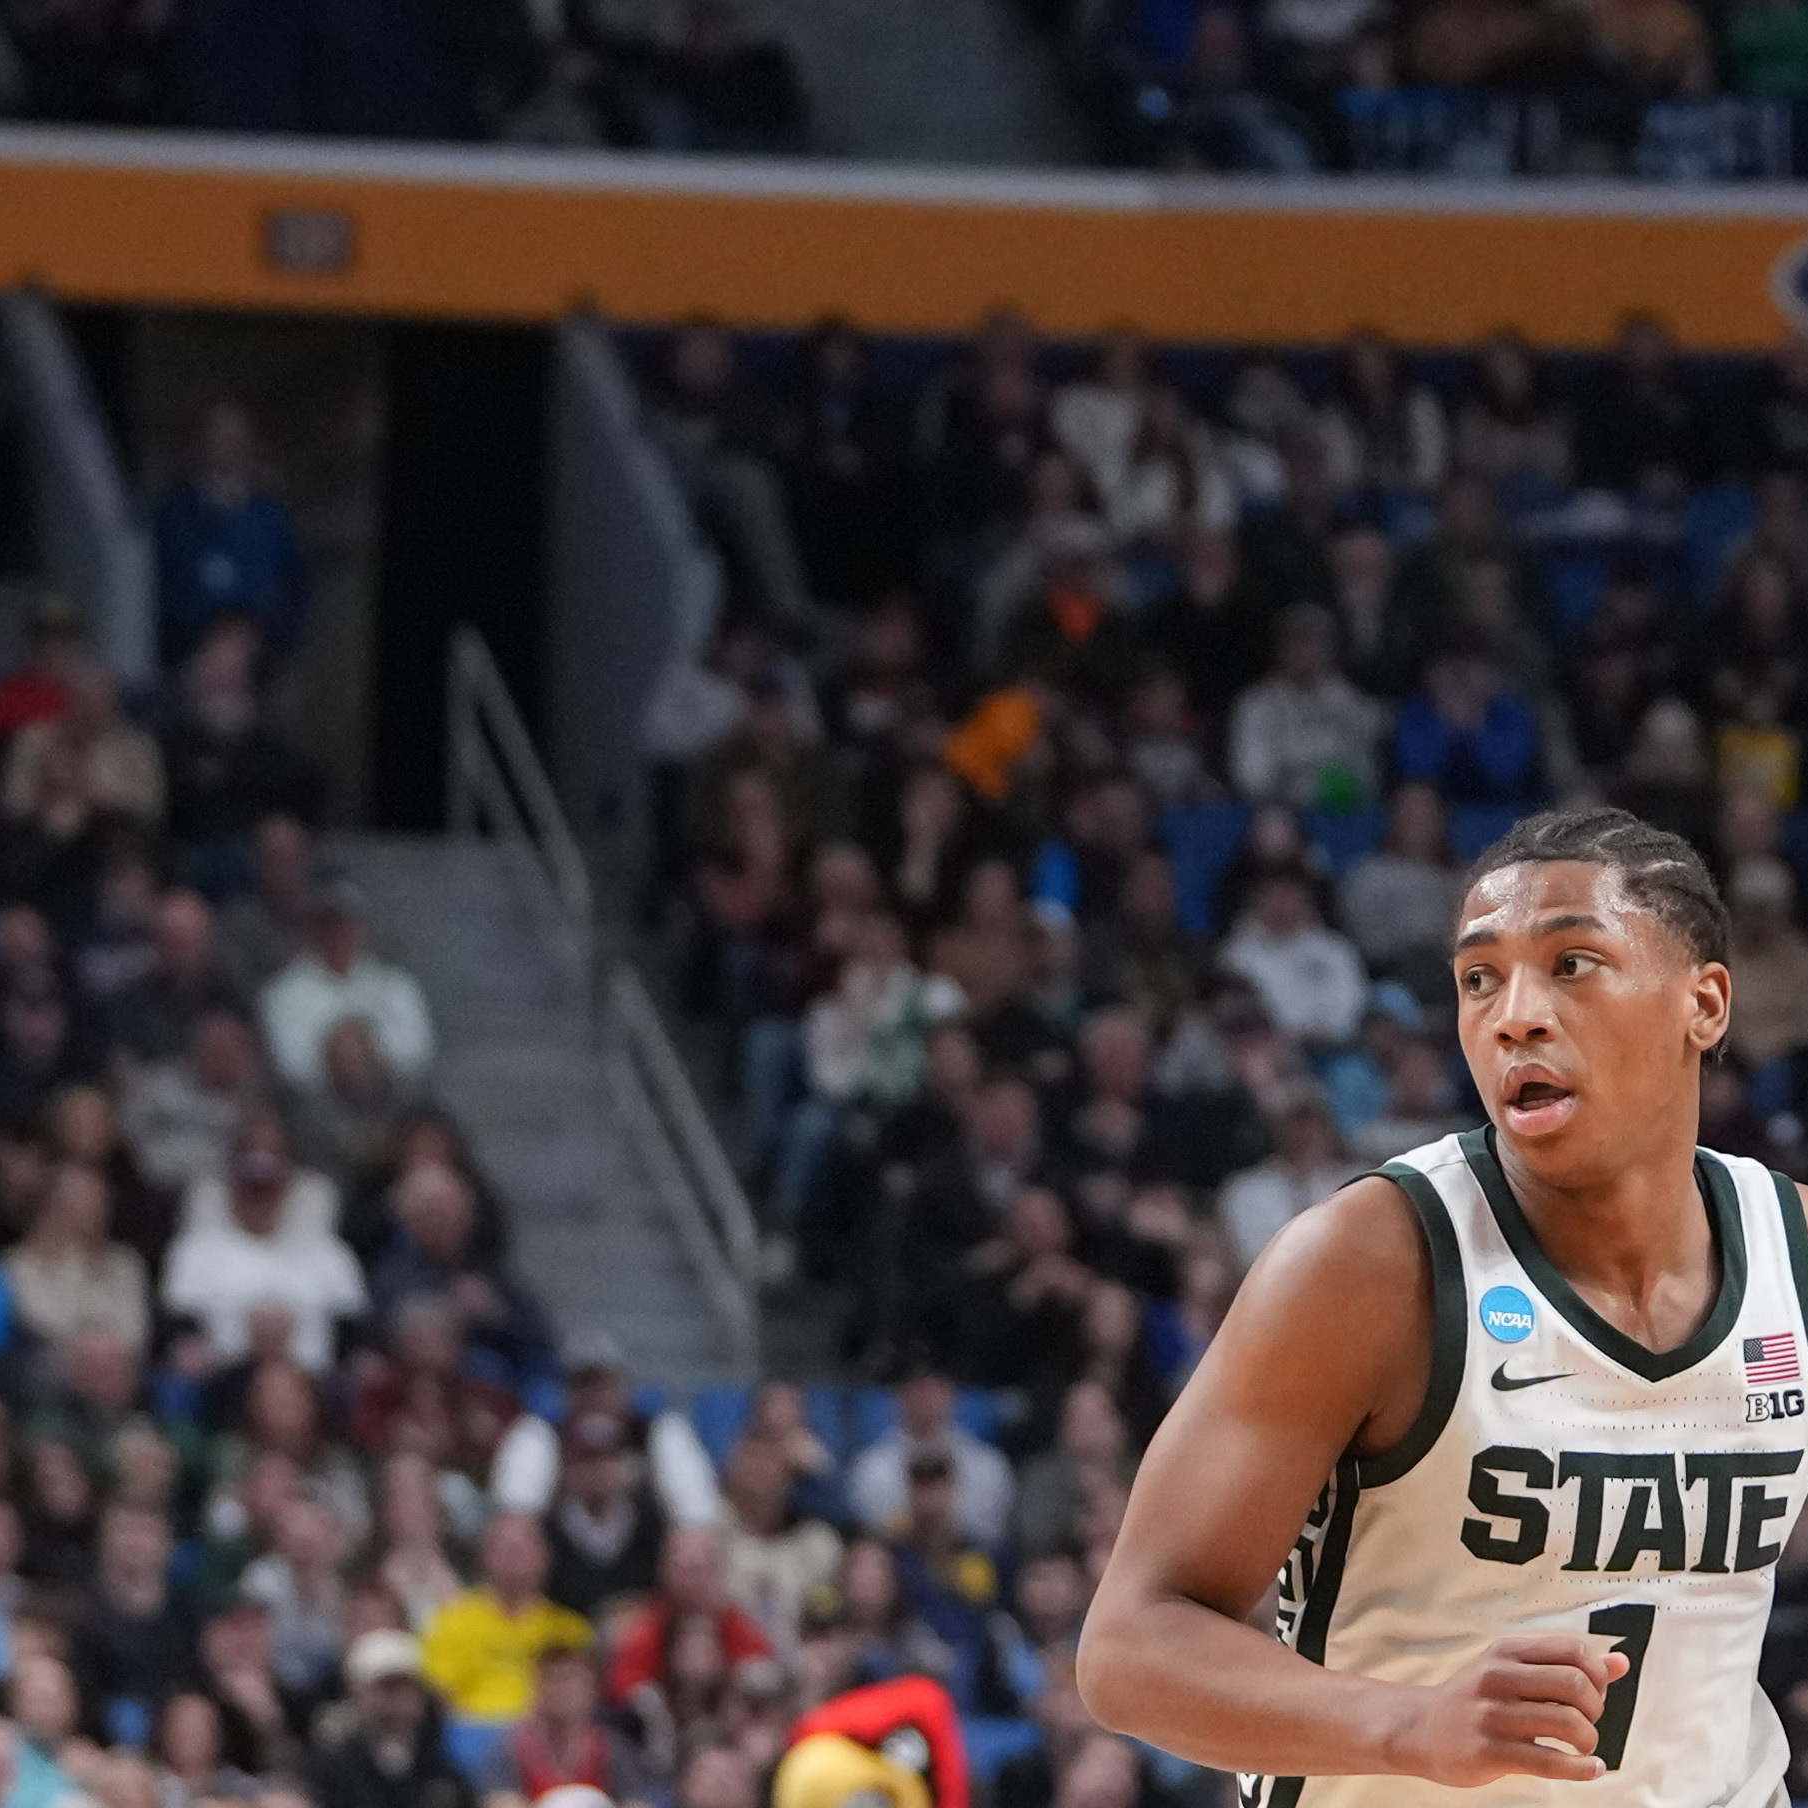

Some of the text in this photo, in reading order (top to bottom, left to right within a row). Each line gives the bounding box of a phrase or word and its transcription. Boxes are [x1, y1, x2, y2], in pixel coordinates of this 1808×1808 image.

[1488, 1310, 1532, 1329] NCAA
[1459, 1444, 1805, 1575] STATE
[1587, 1602, 1657, 1771] 1
